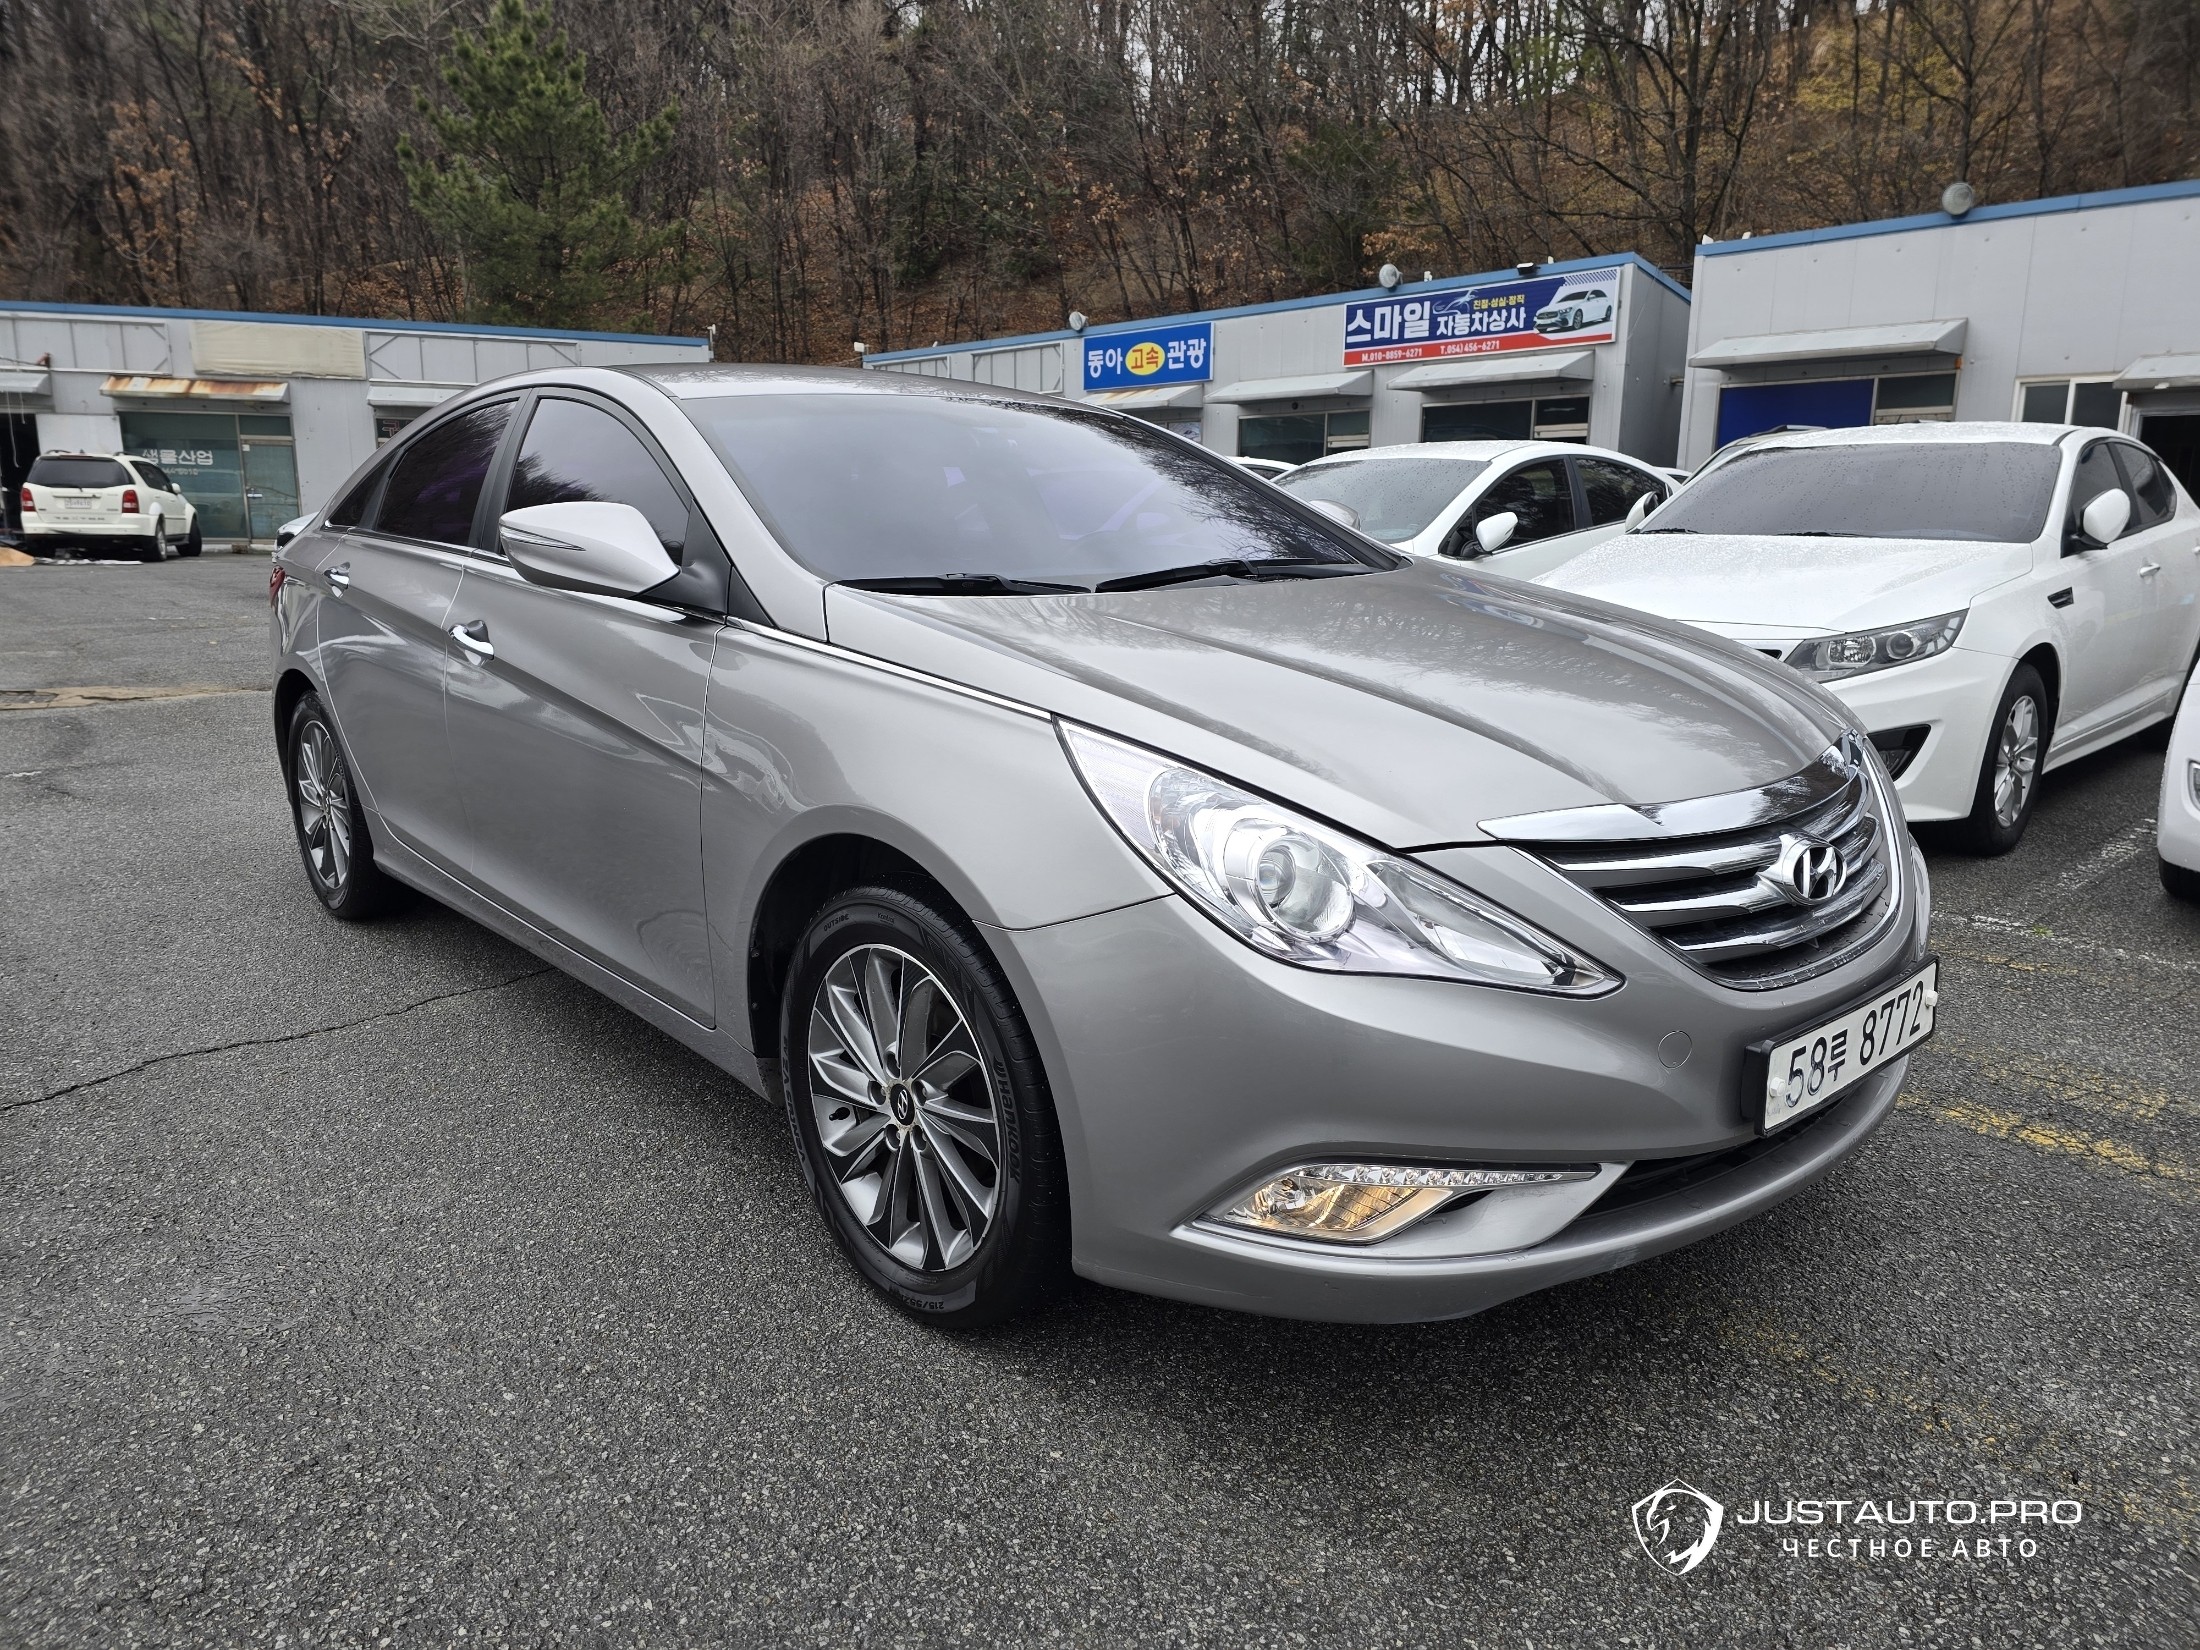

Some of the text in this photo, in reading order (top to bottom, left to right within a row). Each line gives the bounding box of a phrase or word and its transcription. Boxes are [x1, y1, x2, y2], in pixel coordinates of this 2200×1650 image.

[1346, 300, 1526, 343] 스마일 자동차상사
[1087, 338, 1207, 378] 동아 고속 관광
[823, 913, 850, 932] OUTSIDE
[1785, 980, 1924, 1108] 58루 8772
